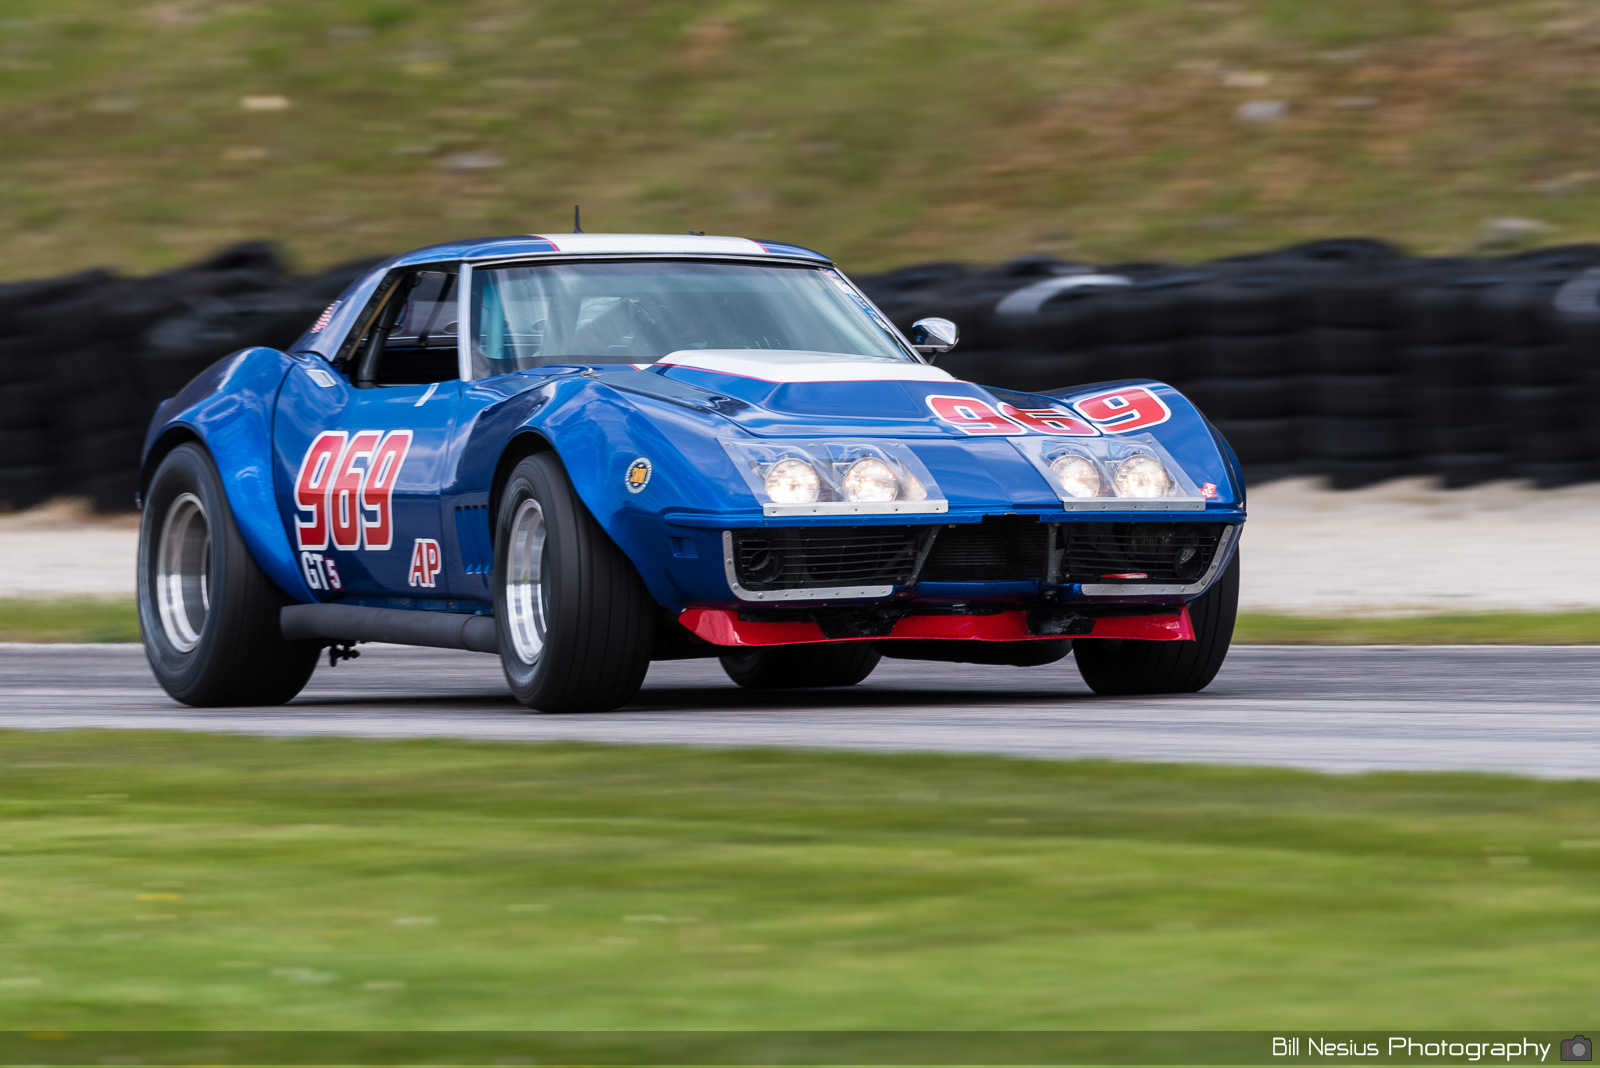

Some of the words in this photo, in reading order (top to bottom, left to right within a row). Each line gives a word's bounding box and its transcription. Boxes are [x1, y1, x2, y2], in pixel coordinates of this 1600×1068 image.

[925, 386, 1171, 436] 969
[294, 429, 414, 551] 969
[408, 538, 442, 588] AP
